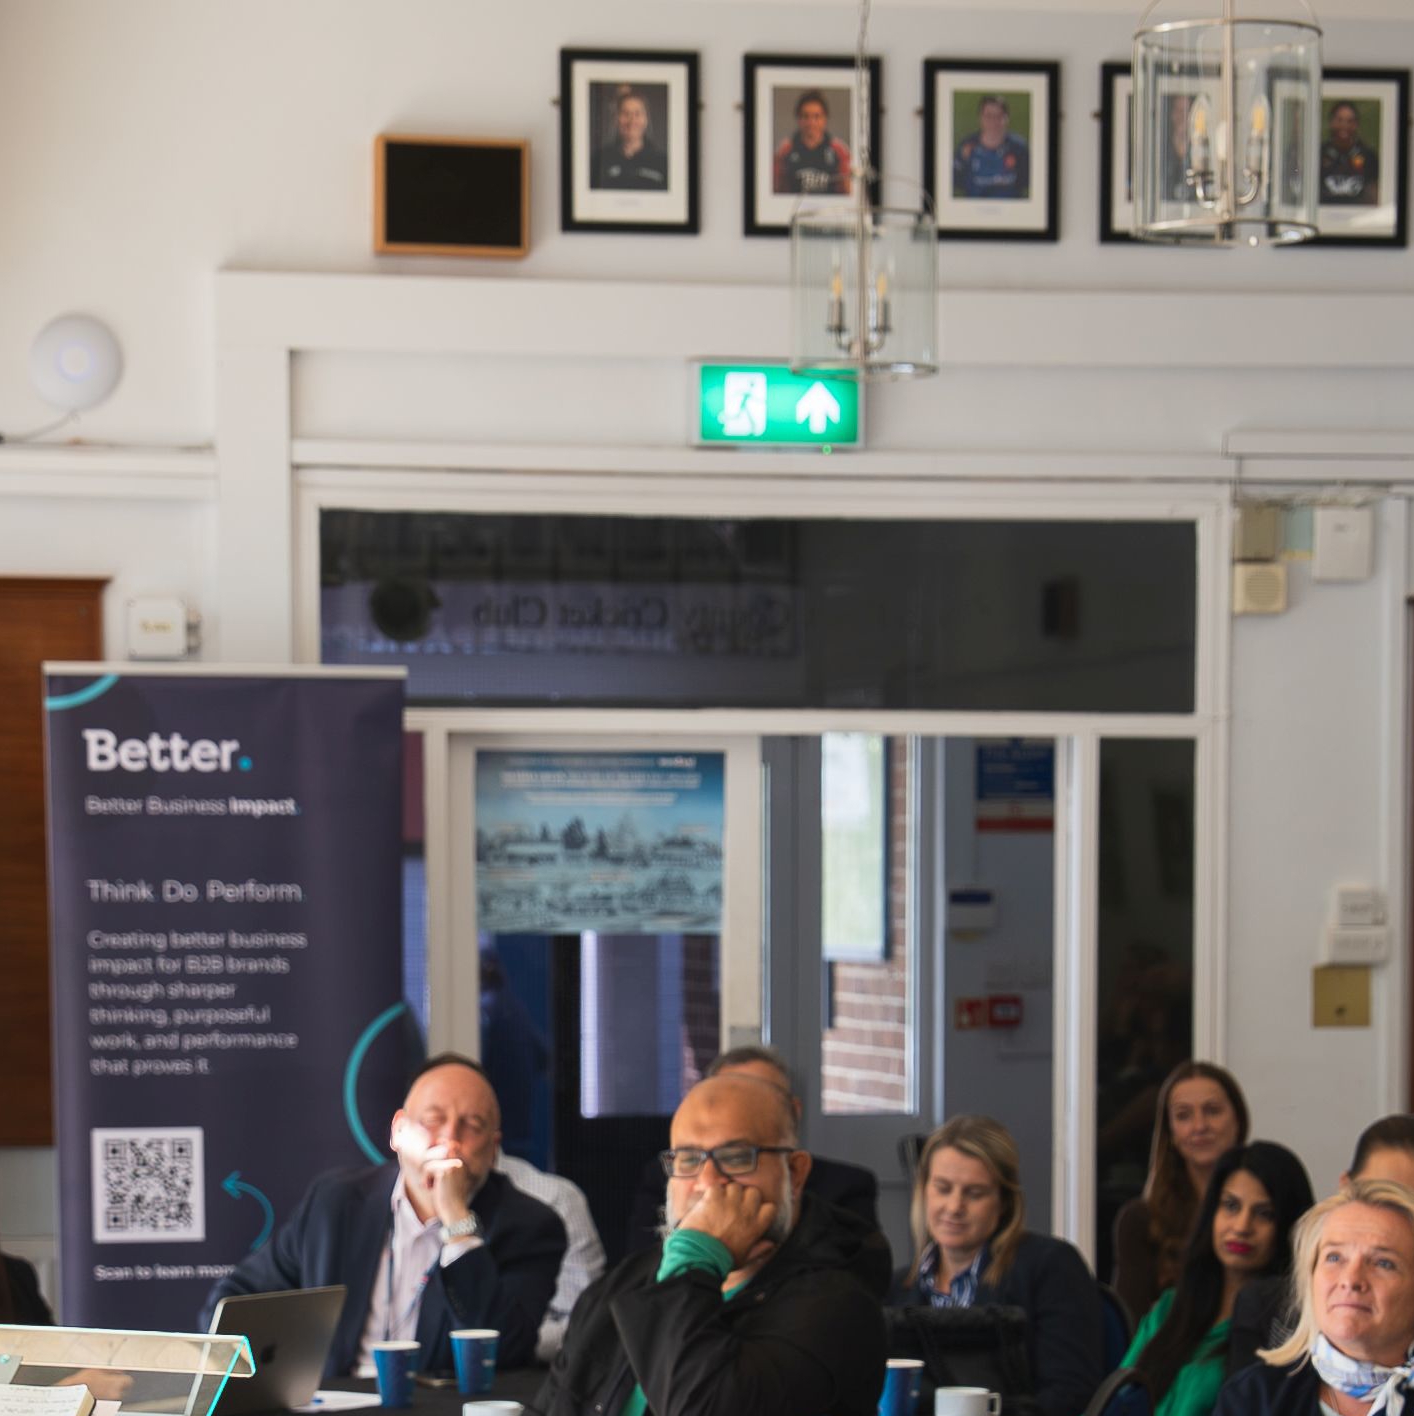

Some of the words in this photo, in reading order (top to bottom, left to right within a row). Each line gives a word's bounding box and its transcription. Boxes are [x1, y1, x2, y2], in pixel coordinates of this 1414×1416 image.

[83, 728, 252, 772] Better.
[86, 796, 143, 816] Better
[145, 795, 227, 816] Business
[88, 930, 167, 952] Creating
[169, 930, 225, 949] better
[228, 930, 308, 949] business
[89, 955, 154, 976] impact
[155, 955, 182, 974] for
[185, 955, 225, 974] B2B
[226, 955, 290, 974] brands
[89, 981, 165, 1002] through
[166, 980, 237, 1002] sharper
[89, 1005, 171, 1028] thinking,
[172, 1004, 271, 1027] purposeful
[89, 1031, 141, 1051] work,
[142, 1031, 180, 1050] and
[181, 1030, 299, 1052] performance
[90, 1057, 129, 1076] that
[131, 1058, 194, 1078] proves
[94, 1265, 133, 1281] Scan
[135, 1265, 153, 1280] to
[154, 1263, 195, 1280] learn
